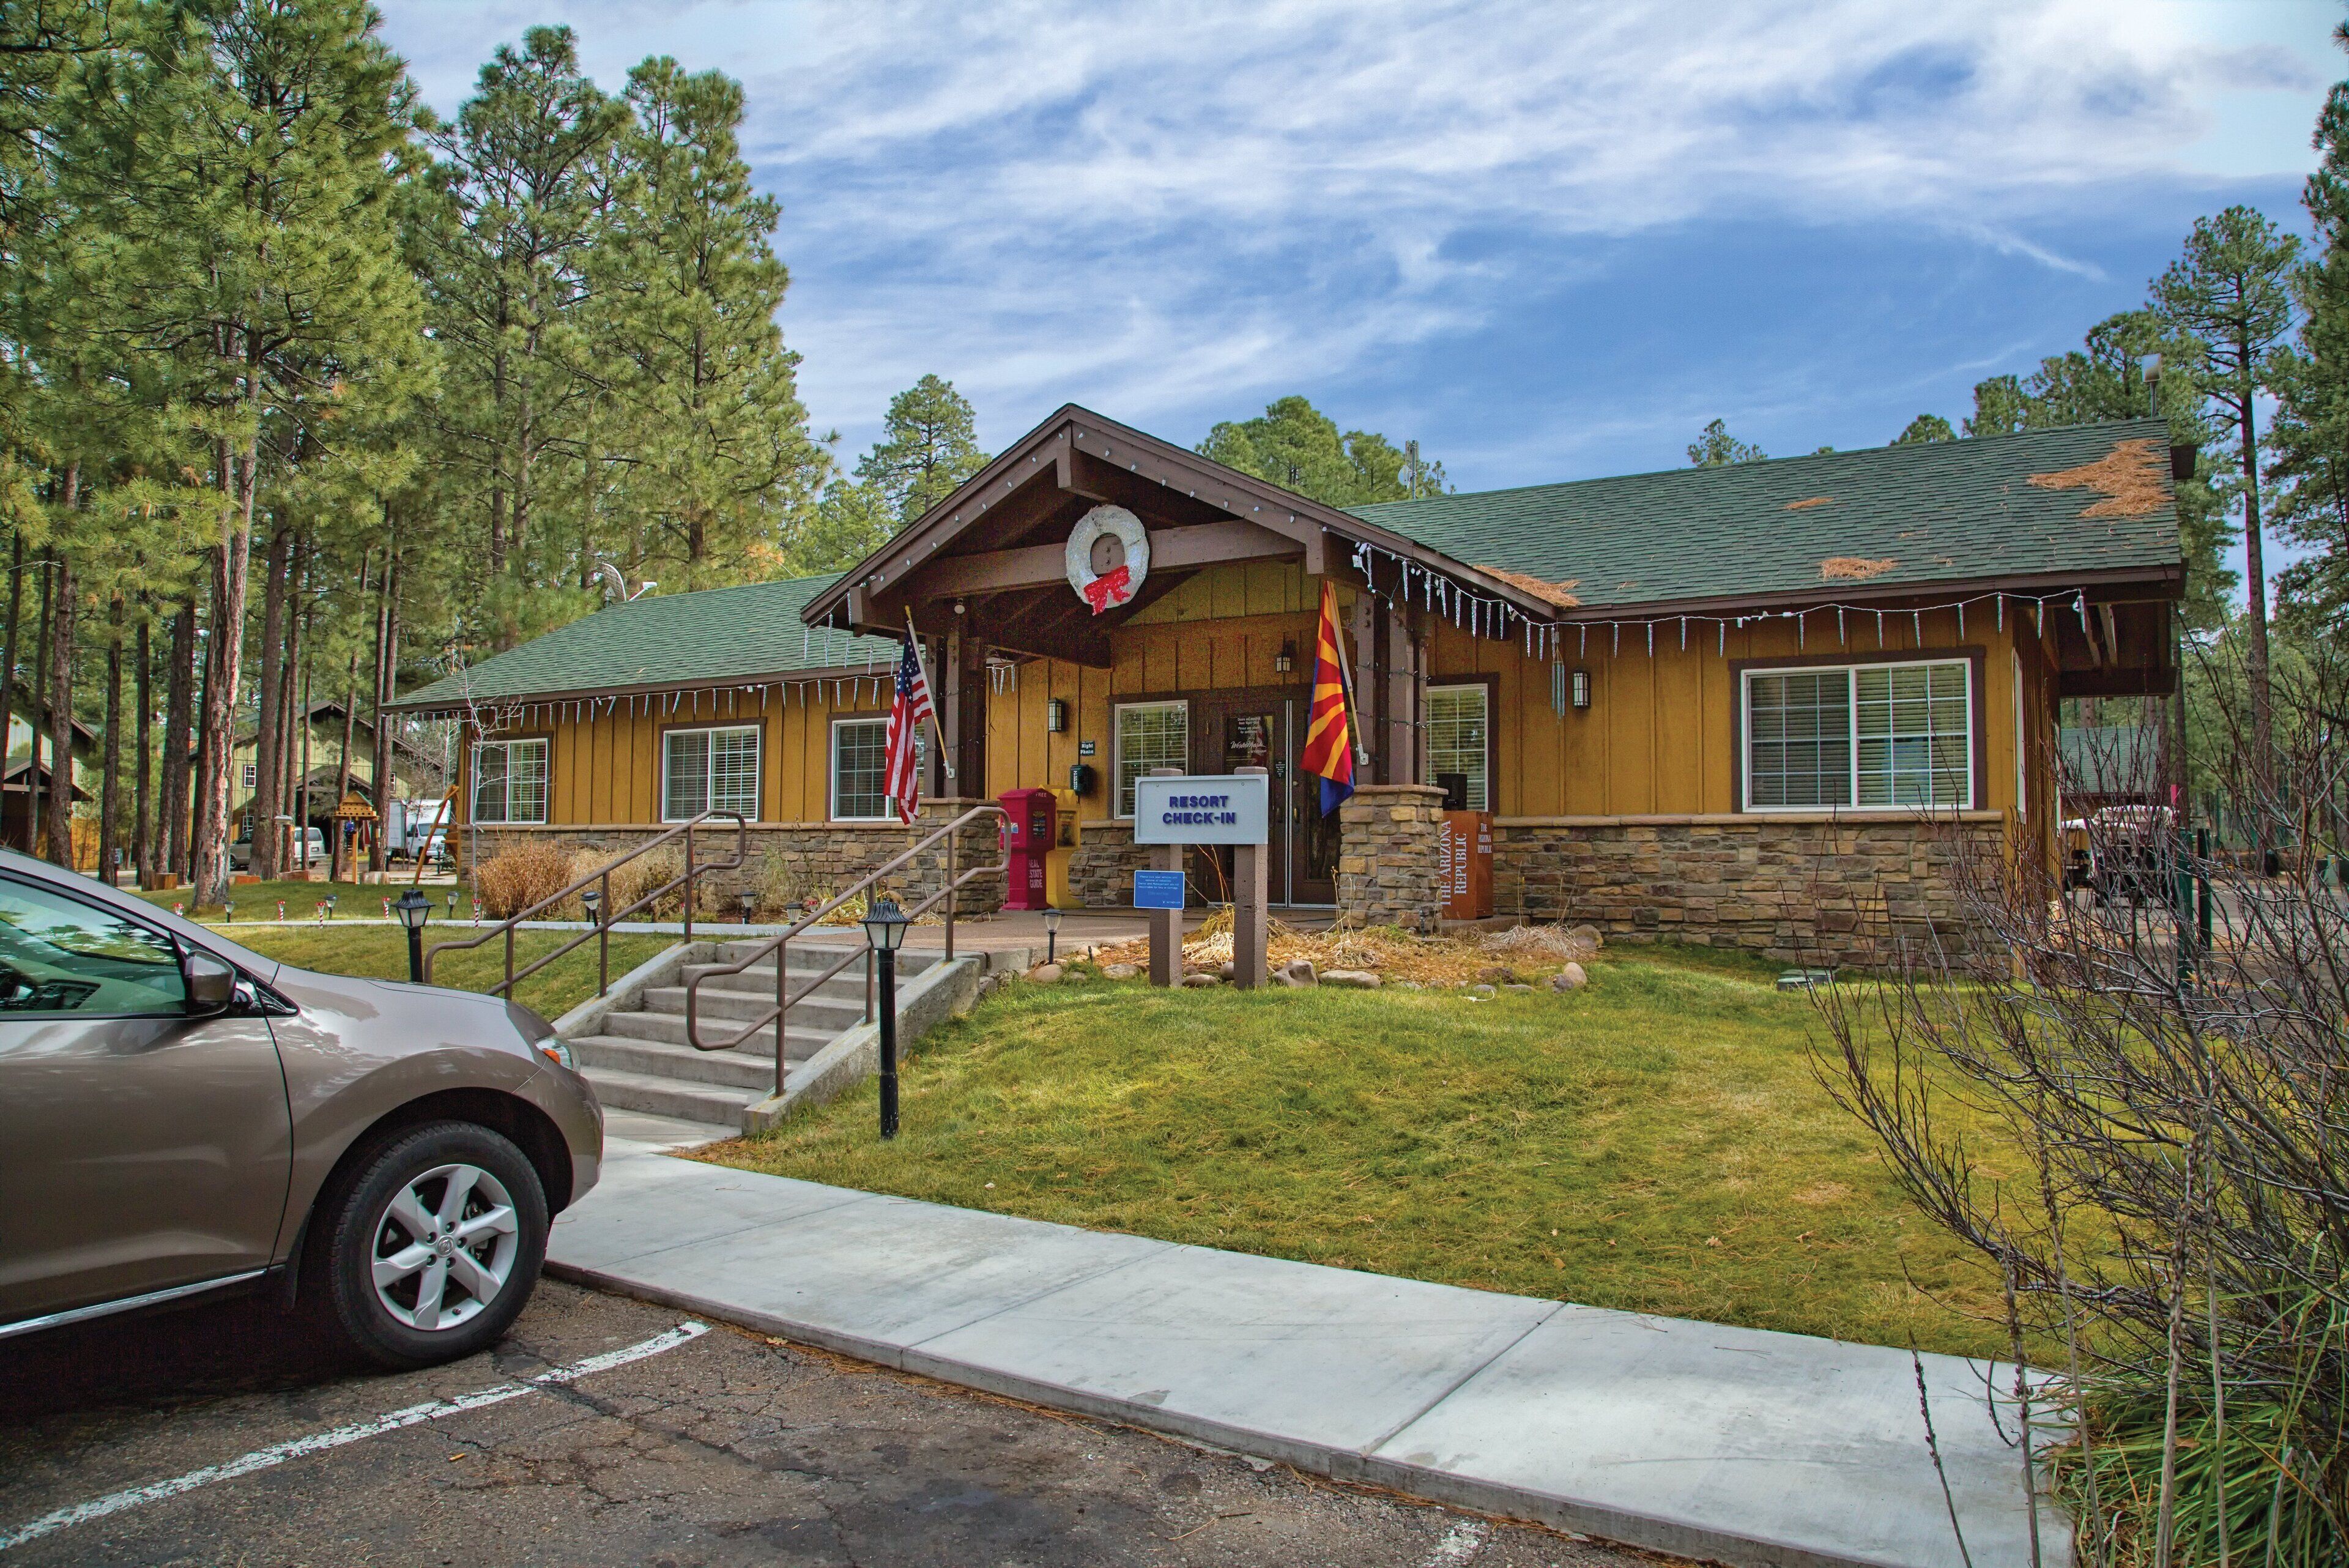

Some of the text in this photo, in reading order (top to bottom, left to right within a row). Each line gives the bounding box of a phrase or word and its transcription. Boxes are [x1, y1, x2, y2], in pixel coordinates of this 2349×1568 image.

[1169, 795, 1228, 808] RESORT
[1162, 812, 1236, 824] CHECK-IN
[1478, 833, 1491, 842] ARIZONA
[1439, 820, 1451, 878] ARIZONA
[1477, 844, 1492, 853] REPUBLIC
[1454, 833, 1467, 895] REPUBLIC
[1028, 869, 1042, 879] STATE
[1030, 879, 1042, 888] GUIDE
